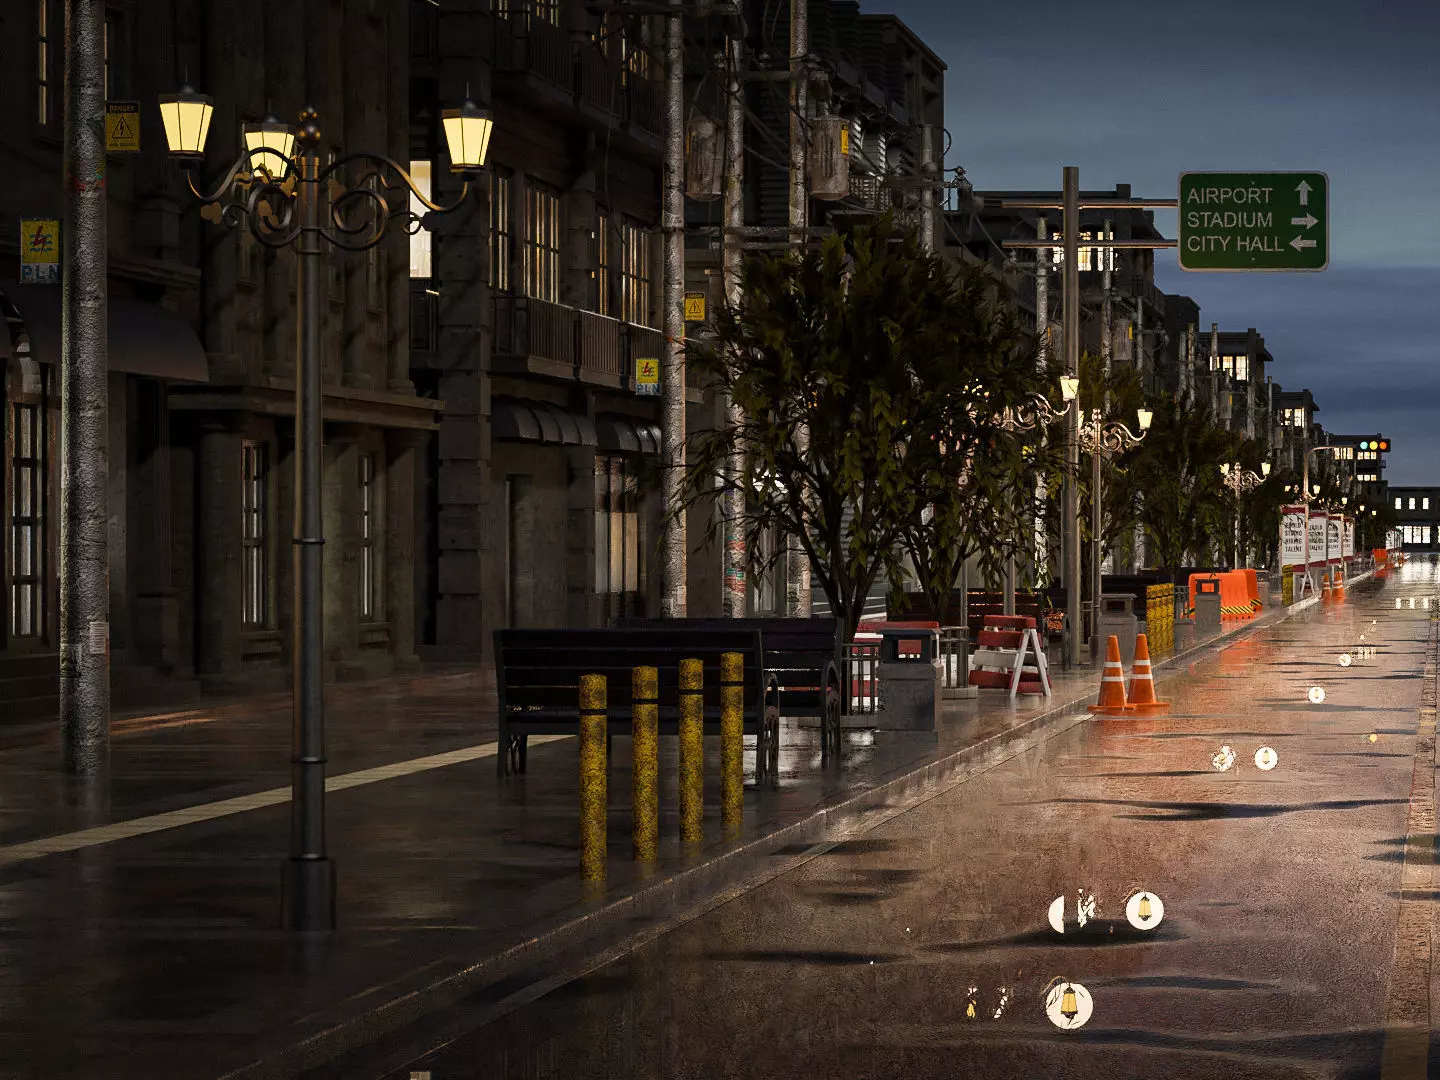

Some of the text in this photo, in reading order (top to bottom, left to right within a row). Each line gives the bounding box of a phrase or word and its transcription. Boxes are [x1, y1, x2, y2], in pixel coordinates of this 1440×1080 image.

[1187, 188, 1273, 204] AIRPORT
[1187, 212, 1273, 228] STADIUM
[1187, 236, 1285, 252] CITY HALL
[22, 264, 61, 280] PLN
[637, 384, 660, 393] PLN
